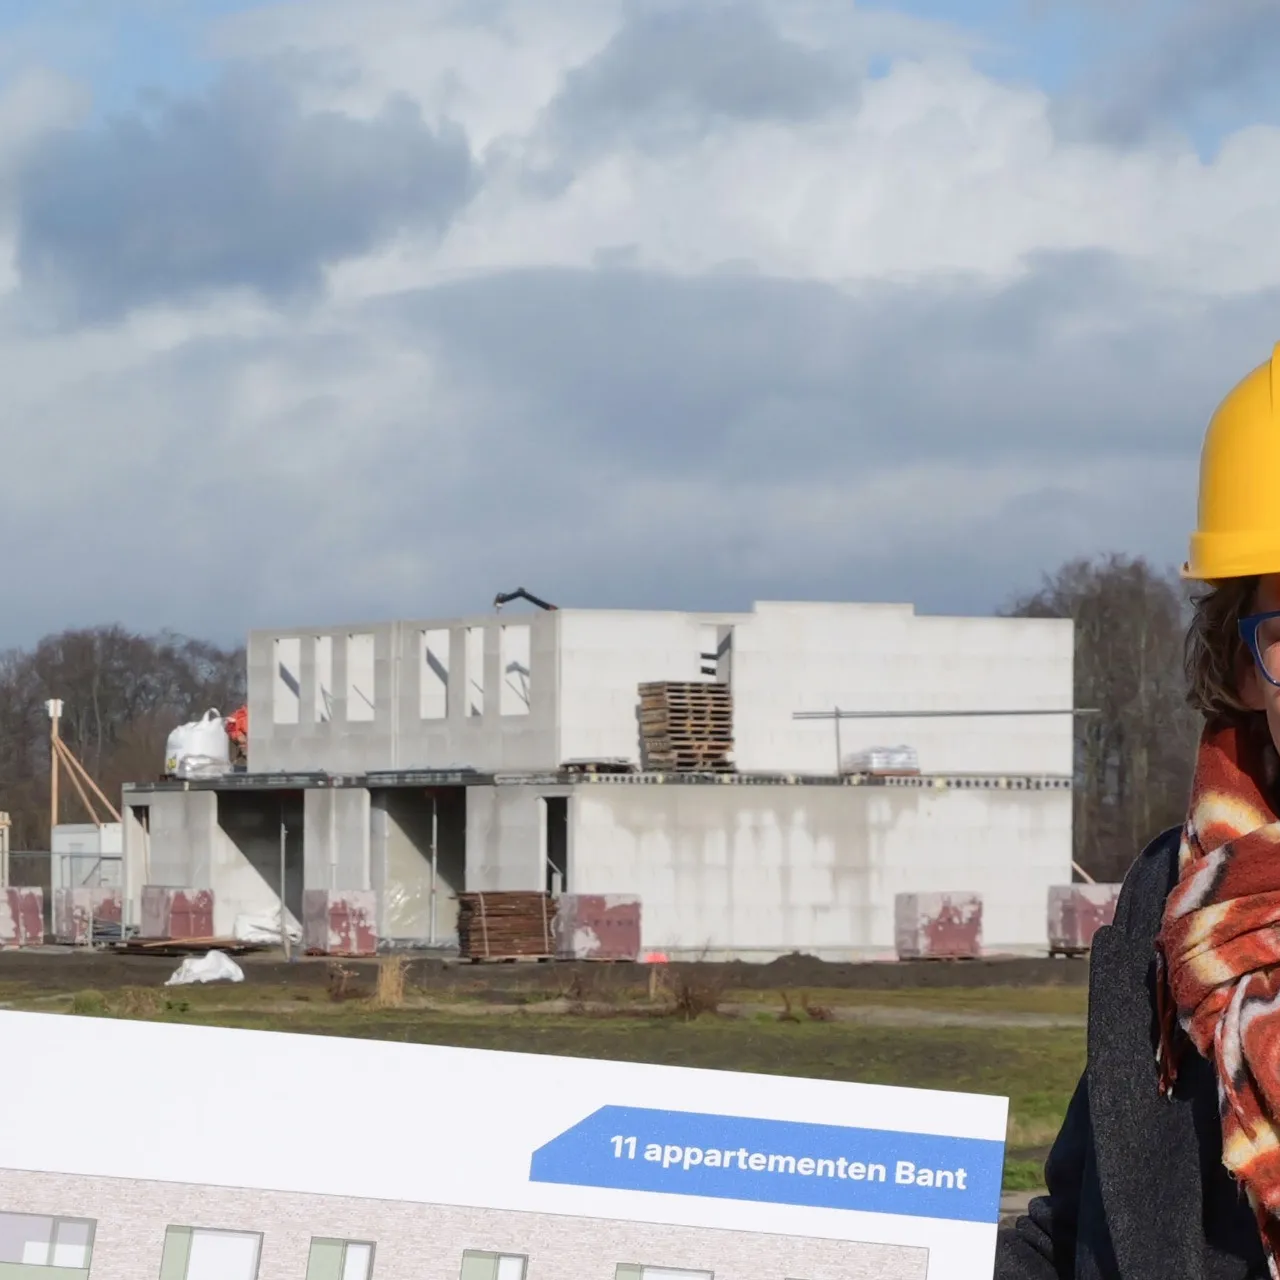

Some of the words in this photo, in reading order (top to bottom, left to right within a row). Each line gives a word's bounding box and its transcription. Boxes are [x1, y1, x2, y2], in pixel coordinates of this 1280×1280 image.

[610, 1135, 637, 1160] 11
[643, 1142, 886, 1182] appartementen
[894, 1160, 968, 1190] Bant
